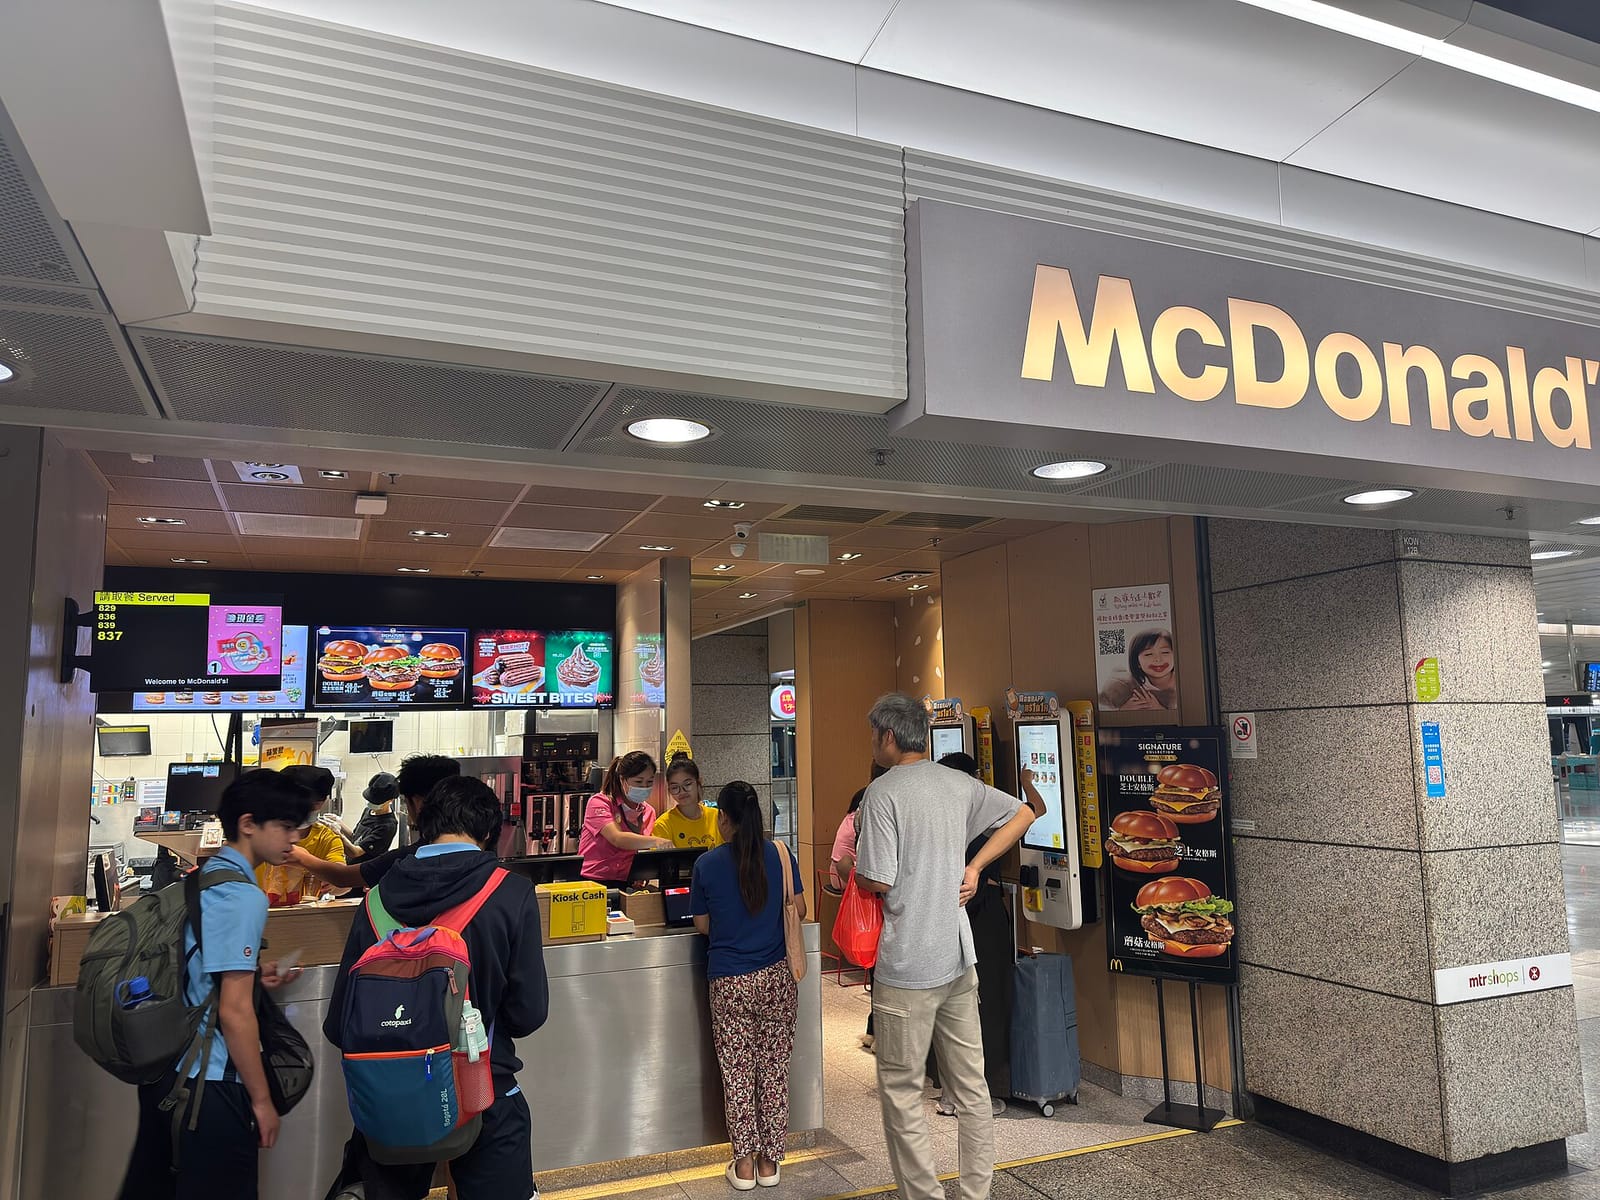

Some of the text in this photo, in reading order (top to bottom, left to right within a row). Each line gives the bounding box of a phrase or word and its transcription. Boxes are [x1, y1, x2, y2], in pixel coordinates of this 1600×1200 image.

[138, 593, 175, 602] Served
[98, 604, 117, 612] 829
[98, 613, 116, 621] 836
[97, 621, 116, 629] 839
[97, 631, 123, 641] 837
[211, 662, 218, 673] 1
[491, 692, 594, 704] SWEET BITES
[1138, 743, 1183, 751] SIGNATURE
[1119, 774, 1155, 783] DOUBLE
[1119, 782, 1155, 792] 芝士安格斯
[1174, 845, 1217, 858] 芝士安格斯
[552, 891, 604, 903] Kiosk Cash
[1469, 968, 1519, 988] mtrshops
[380, 1018, 412, 1028] cotopaxi
